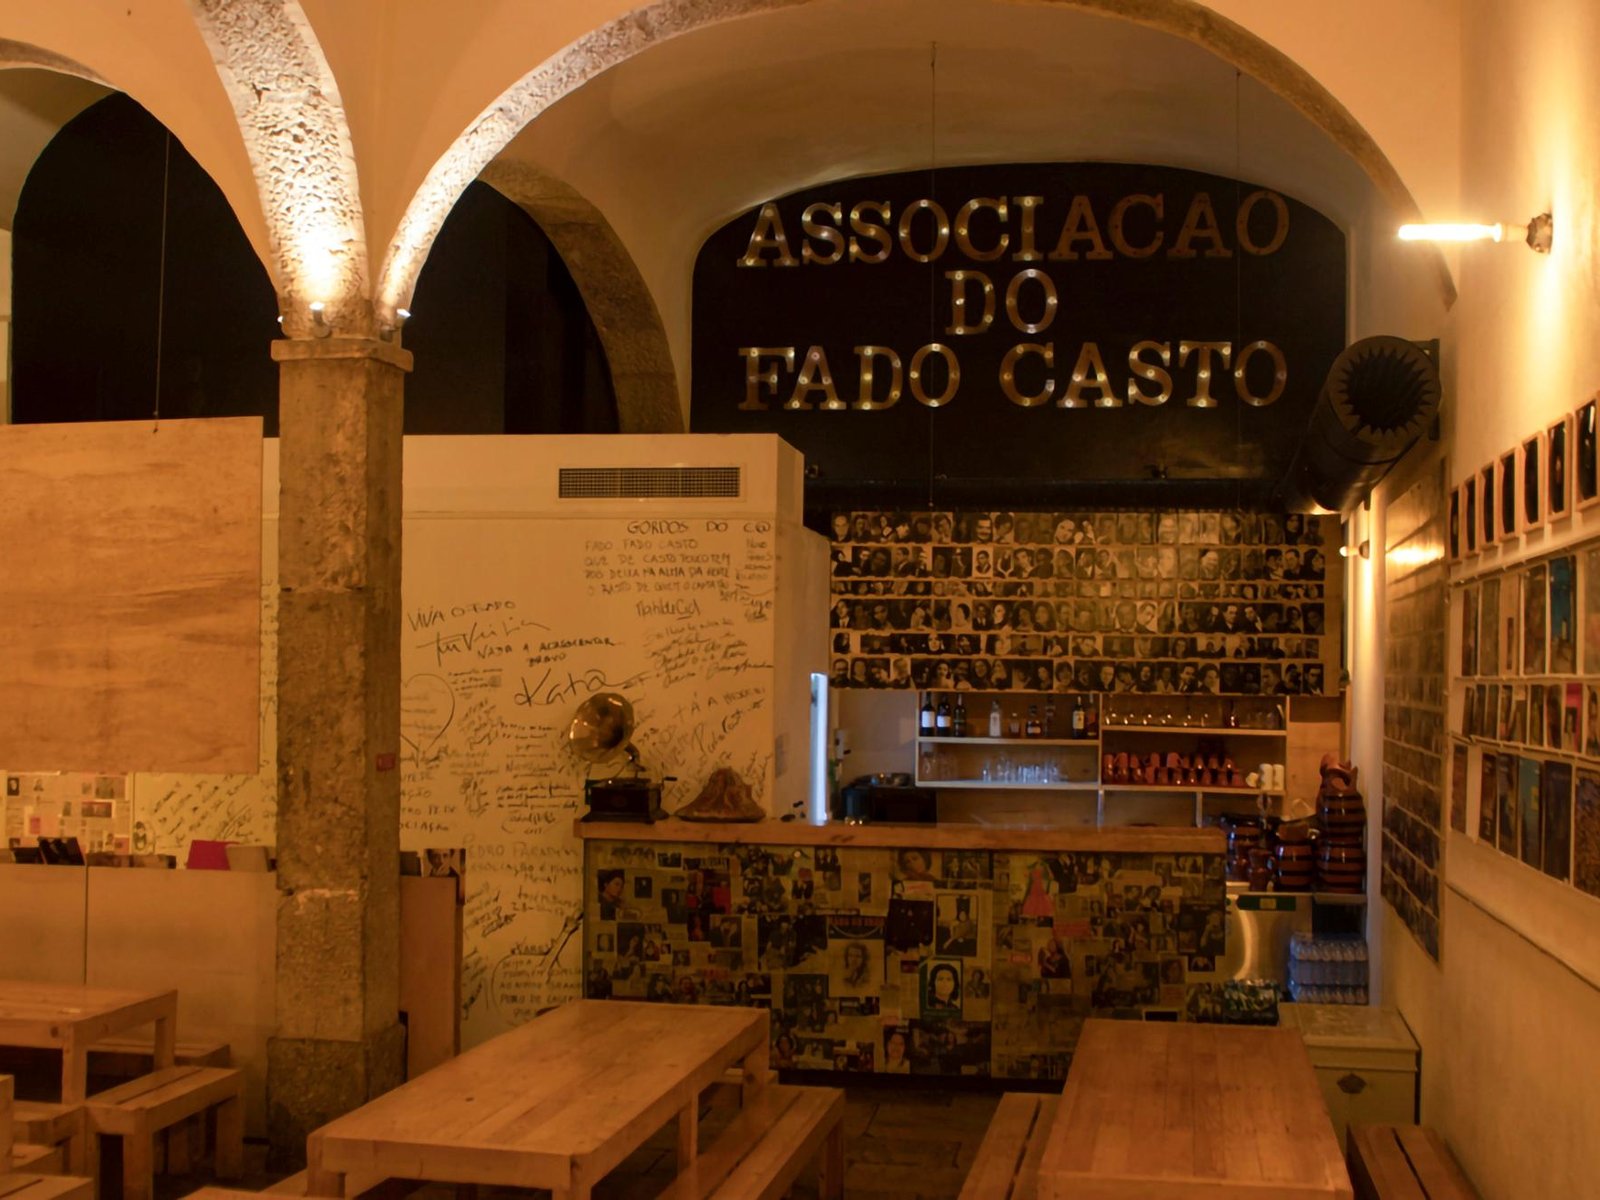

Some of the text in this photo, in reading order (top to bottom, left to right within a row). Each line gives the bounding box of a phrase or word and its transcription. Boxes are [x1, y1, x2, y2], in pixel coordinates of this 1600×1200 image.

[737, 192, 1290, 268] ASSOCIACAO
[945, 268, 1058, 335] DO
[738, 340, 1288, 411] FADO CASTO
[627, 520, 688, 535] GORDOS
[706, 521, 729, 533] DO
[585, 538, 699, 551] FADO FADO CASTO
[658, 567, 686, 578] ALMA
[407, 605, 445, 633] VIVA
